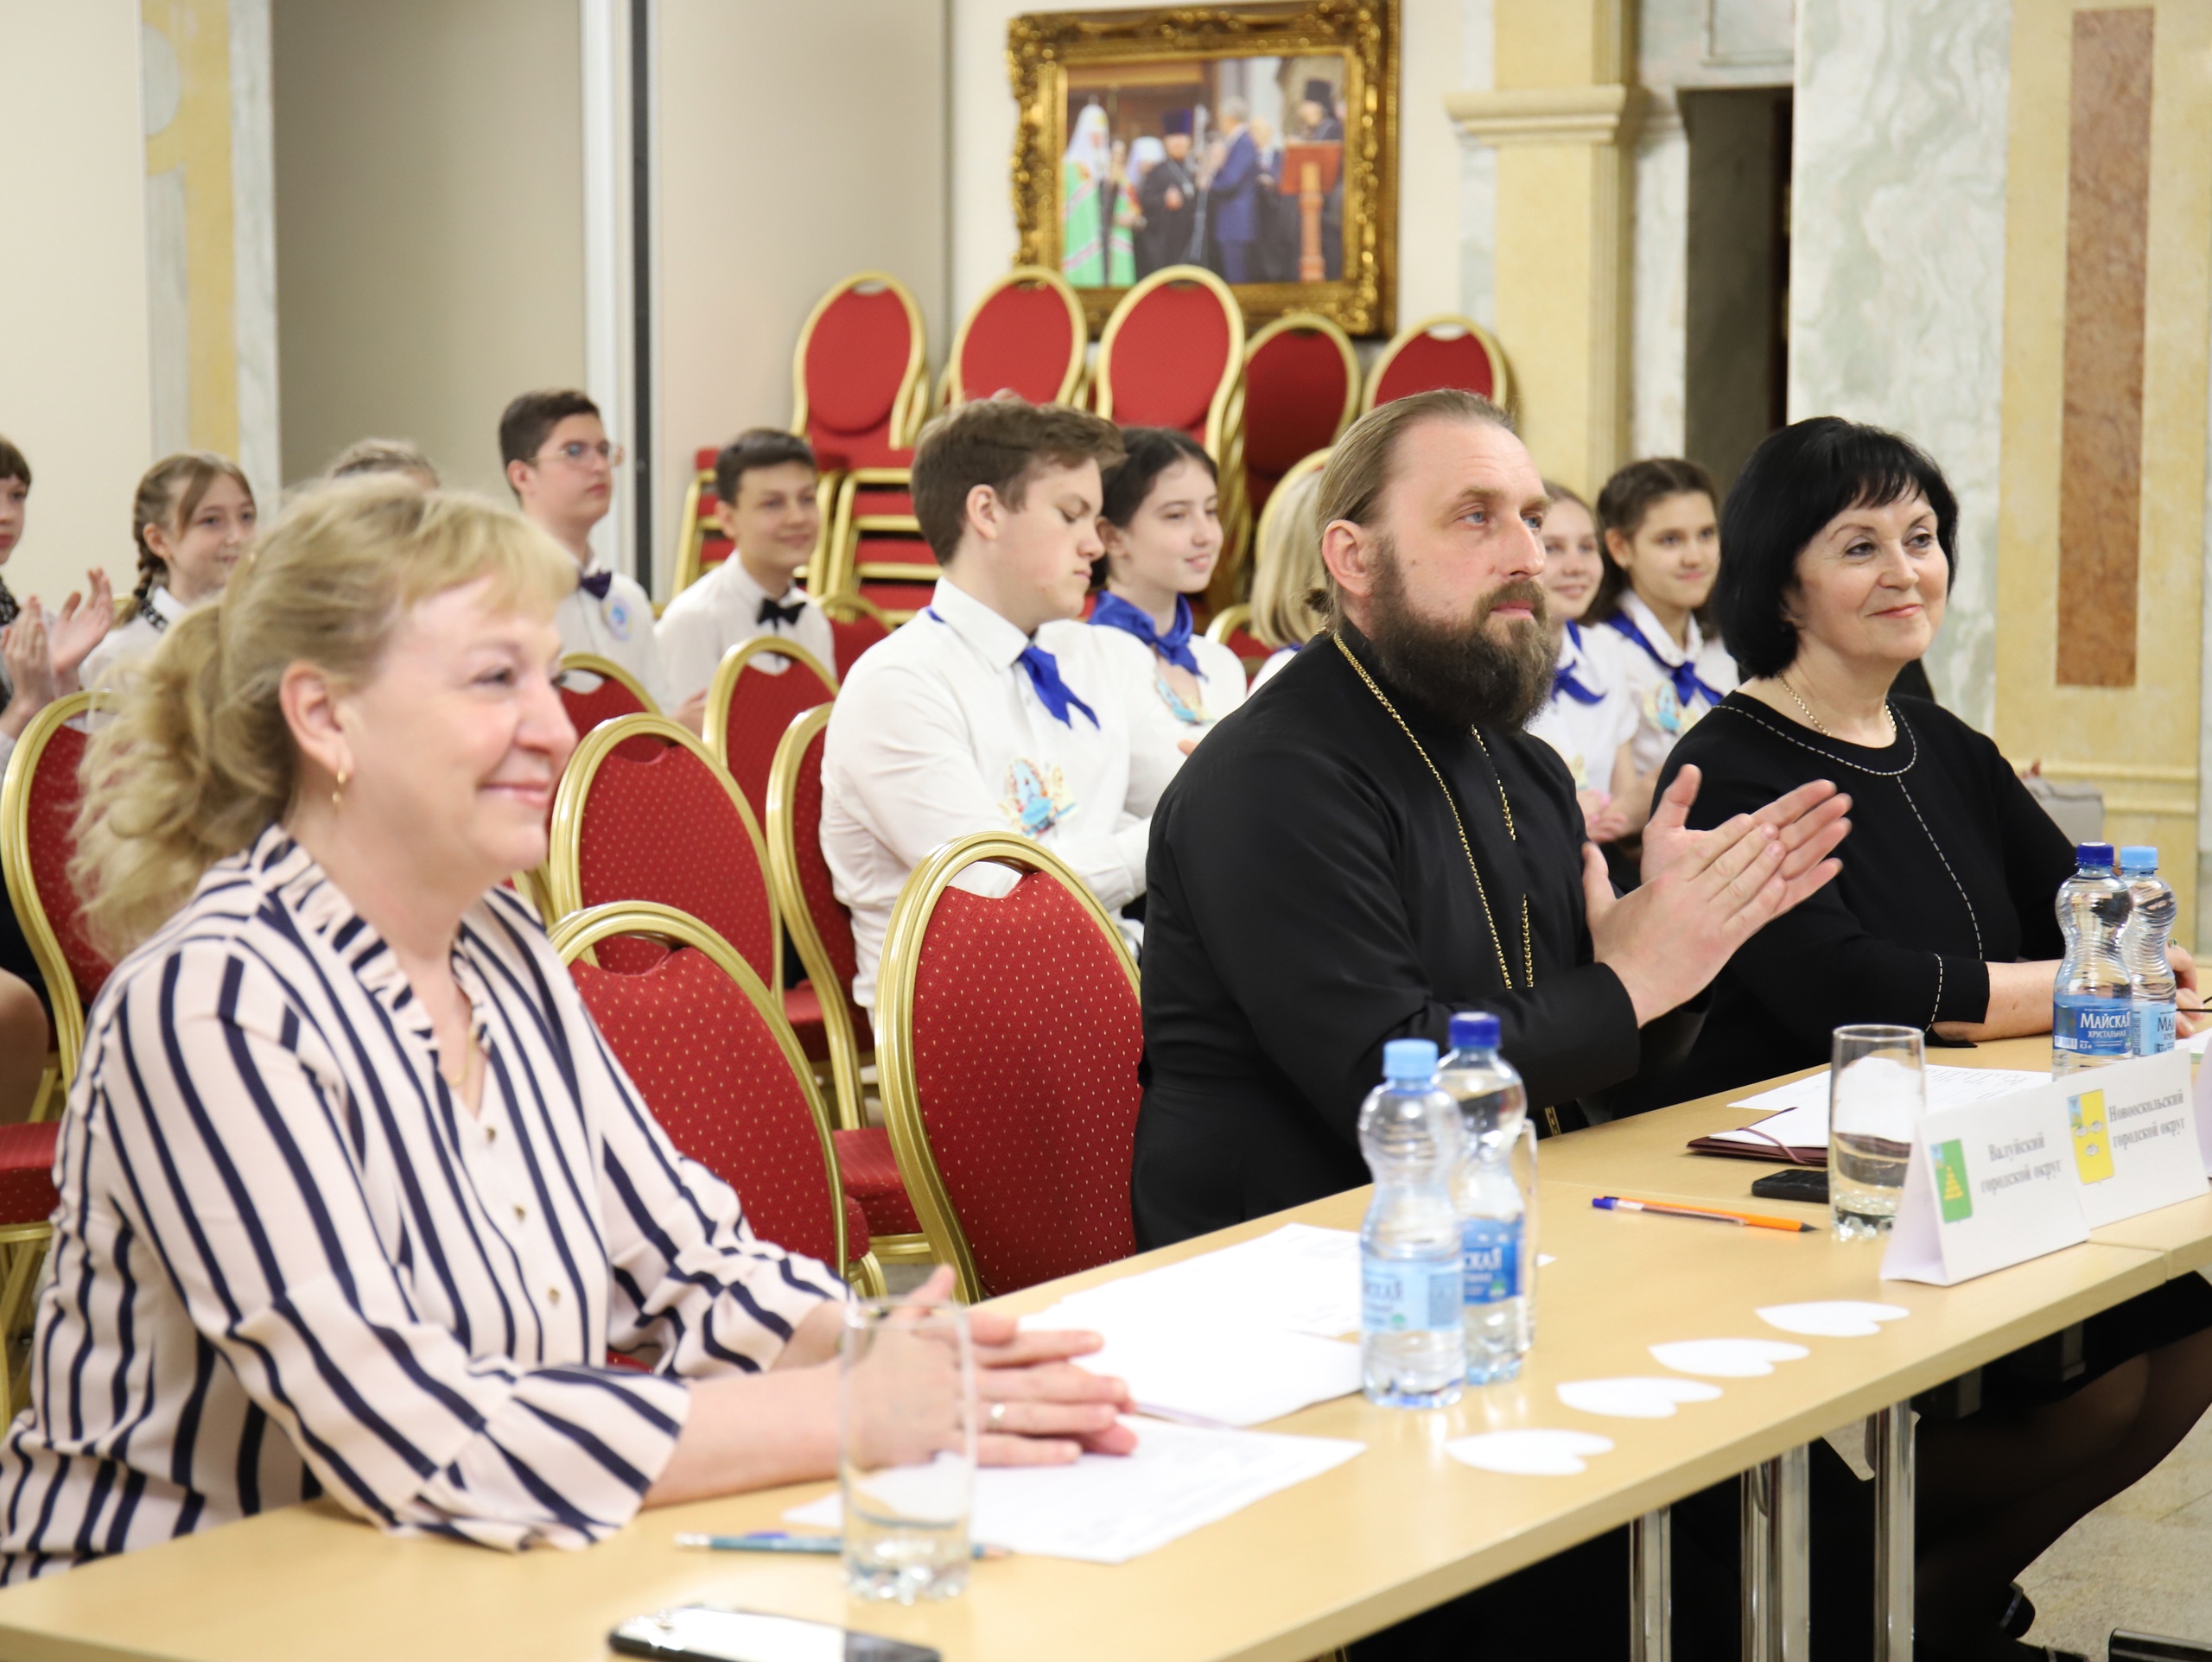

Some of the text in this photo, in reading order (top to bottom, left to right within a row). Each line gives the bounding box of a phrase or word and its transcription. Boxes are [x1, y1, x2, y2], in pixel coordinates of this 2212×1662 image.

[2081, 1012, 2131, 1028] МАЙСКАЯ
[2108, 1088, 2183, 1122] Новооскольский
[1988, 1131, 2045, 1162] Валуйский
[2113, 1118, 2185, 1150] городской округ
[1980, 1159, 2062, 1196] городской округ
